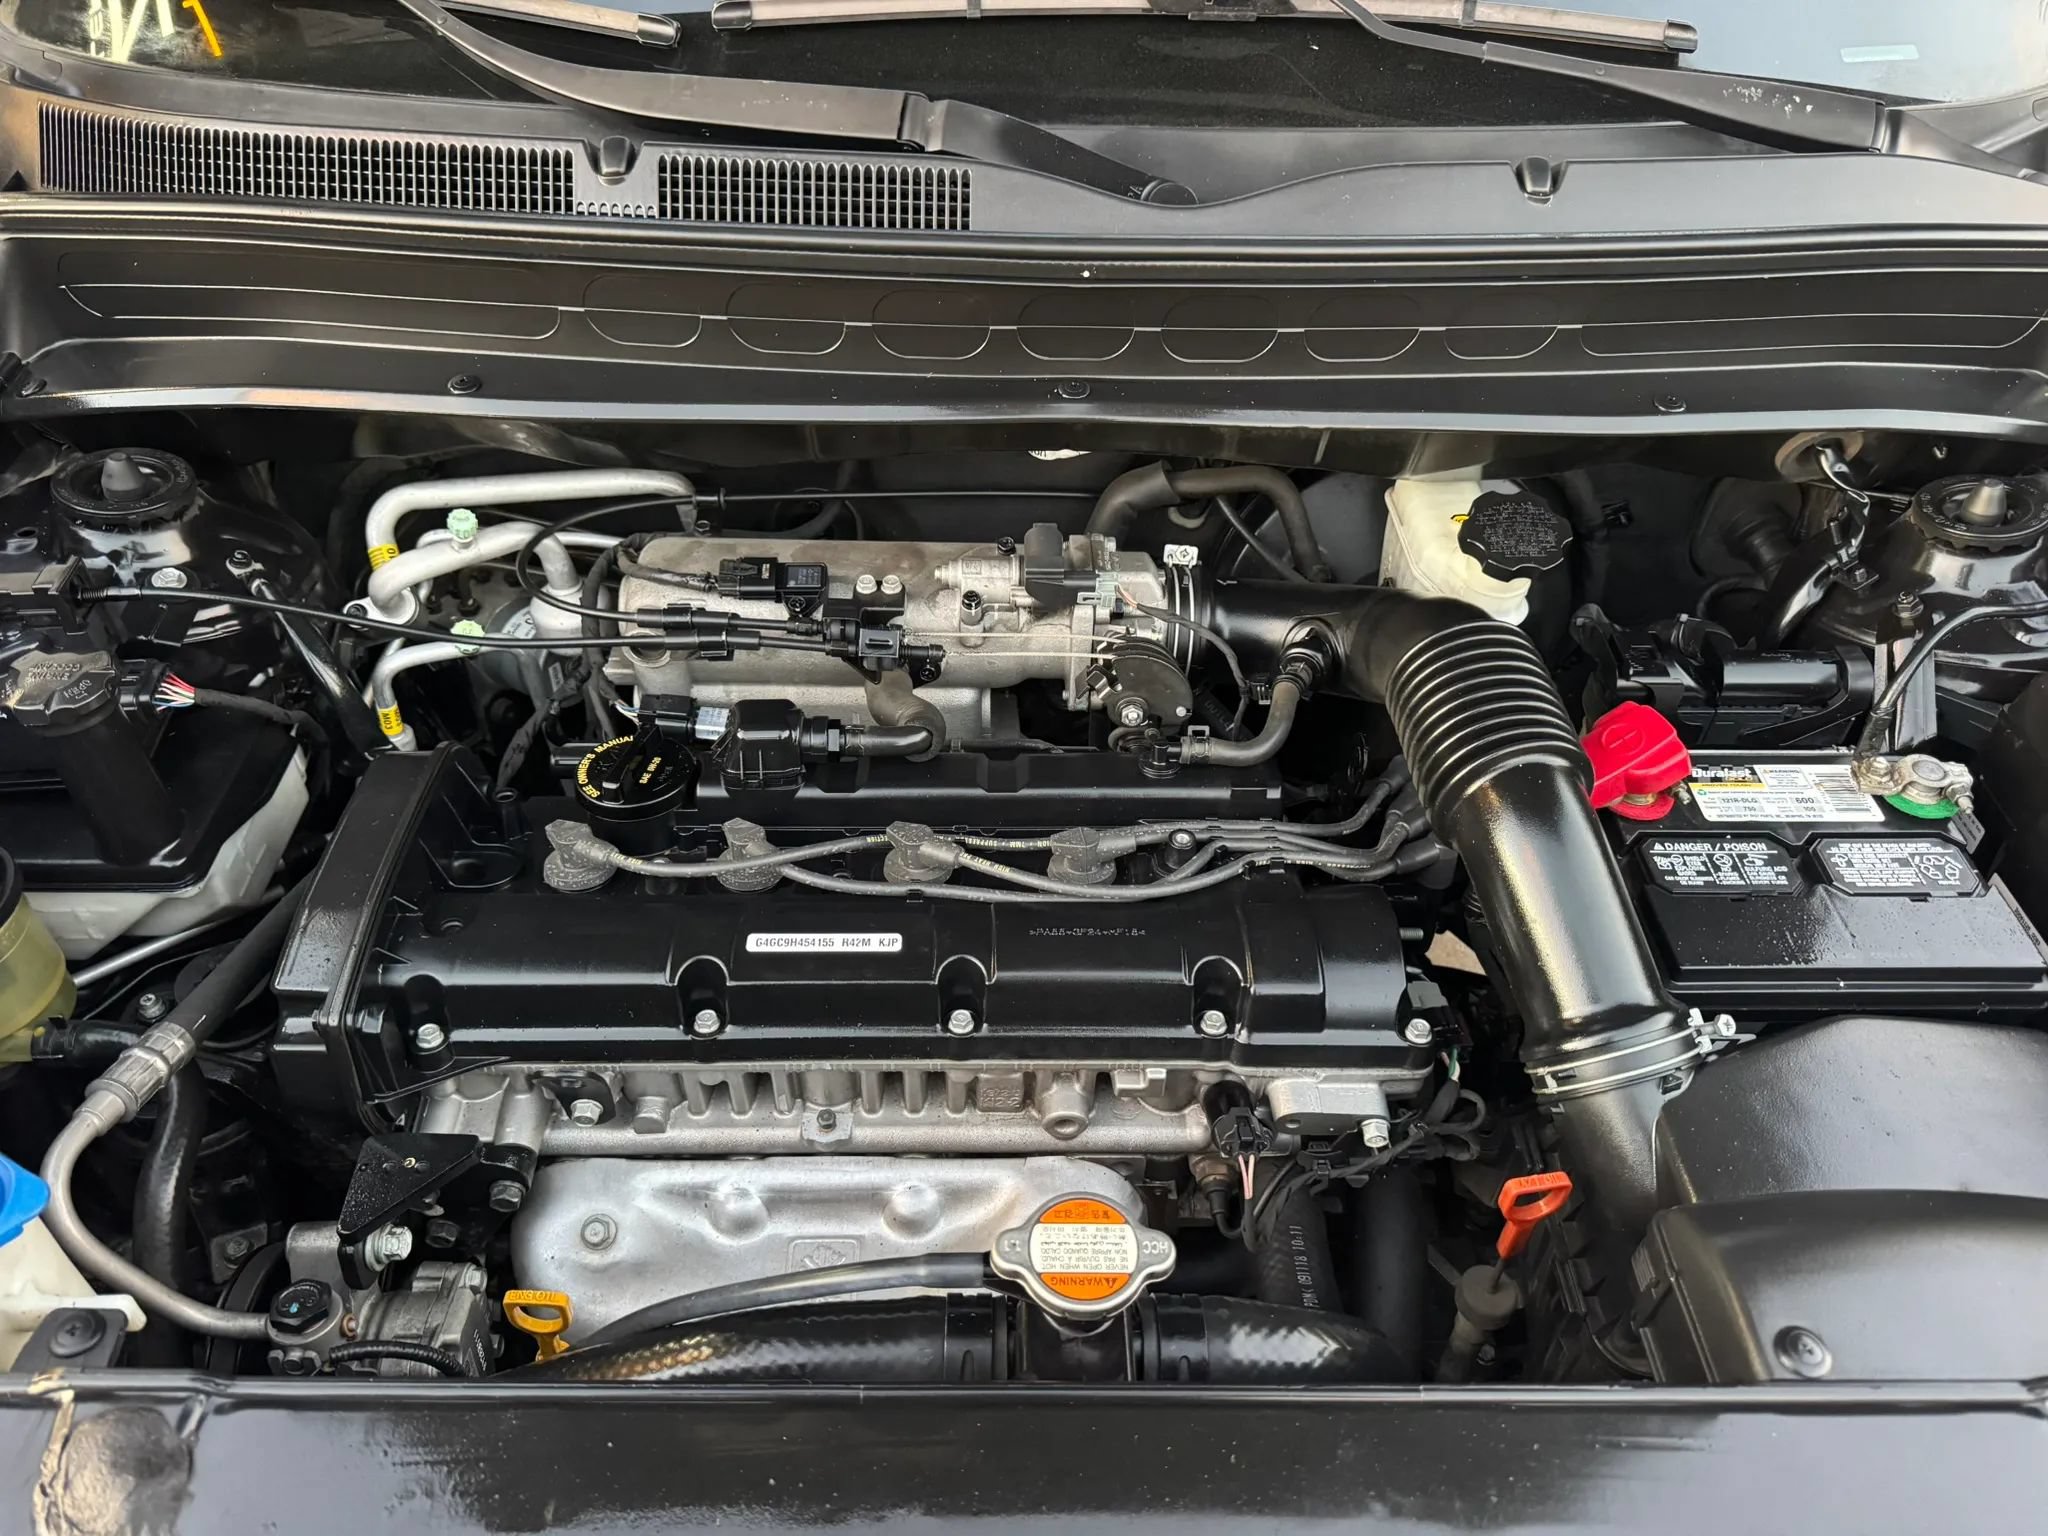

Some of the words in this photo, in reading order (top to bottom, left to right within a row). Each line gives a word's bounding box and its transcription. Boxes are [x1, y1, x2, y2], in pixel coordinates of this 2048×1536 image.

[63, 678, 93, 699] OPEN
[577, 753, 596, 785] OWNER'S
[1691, 767, 1752, 778] Duralast
[582, 784, 601, 799] SEE
[1664, 842, 1713, 851] DANGER
[1715, 843, 1721, 851] /
[1723, 842, 1768, 851] POISON
[755, 937, 835, 948] G4GC9H454155
[842, 937, 871, 948] R42M
[878, 937, 899, 948] KJP
[1288, 1225, 1305, 1251] 10:11
[1142, 1240, 1169, 1254] HCC
[1075, 1255, 1100, 1263] OUVRIR
[1103, 1255, 1116, 1263] PAS
[1119, 1255, 1129, 1263] NE
[1294, 1256, 1312, 1286] 091118
[1050, 1276, 1104, 1287] WARNING
[510, 1290, 534, 1301] ENG
